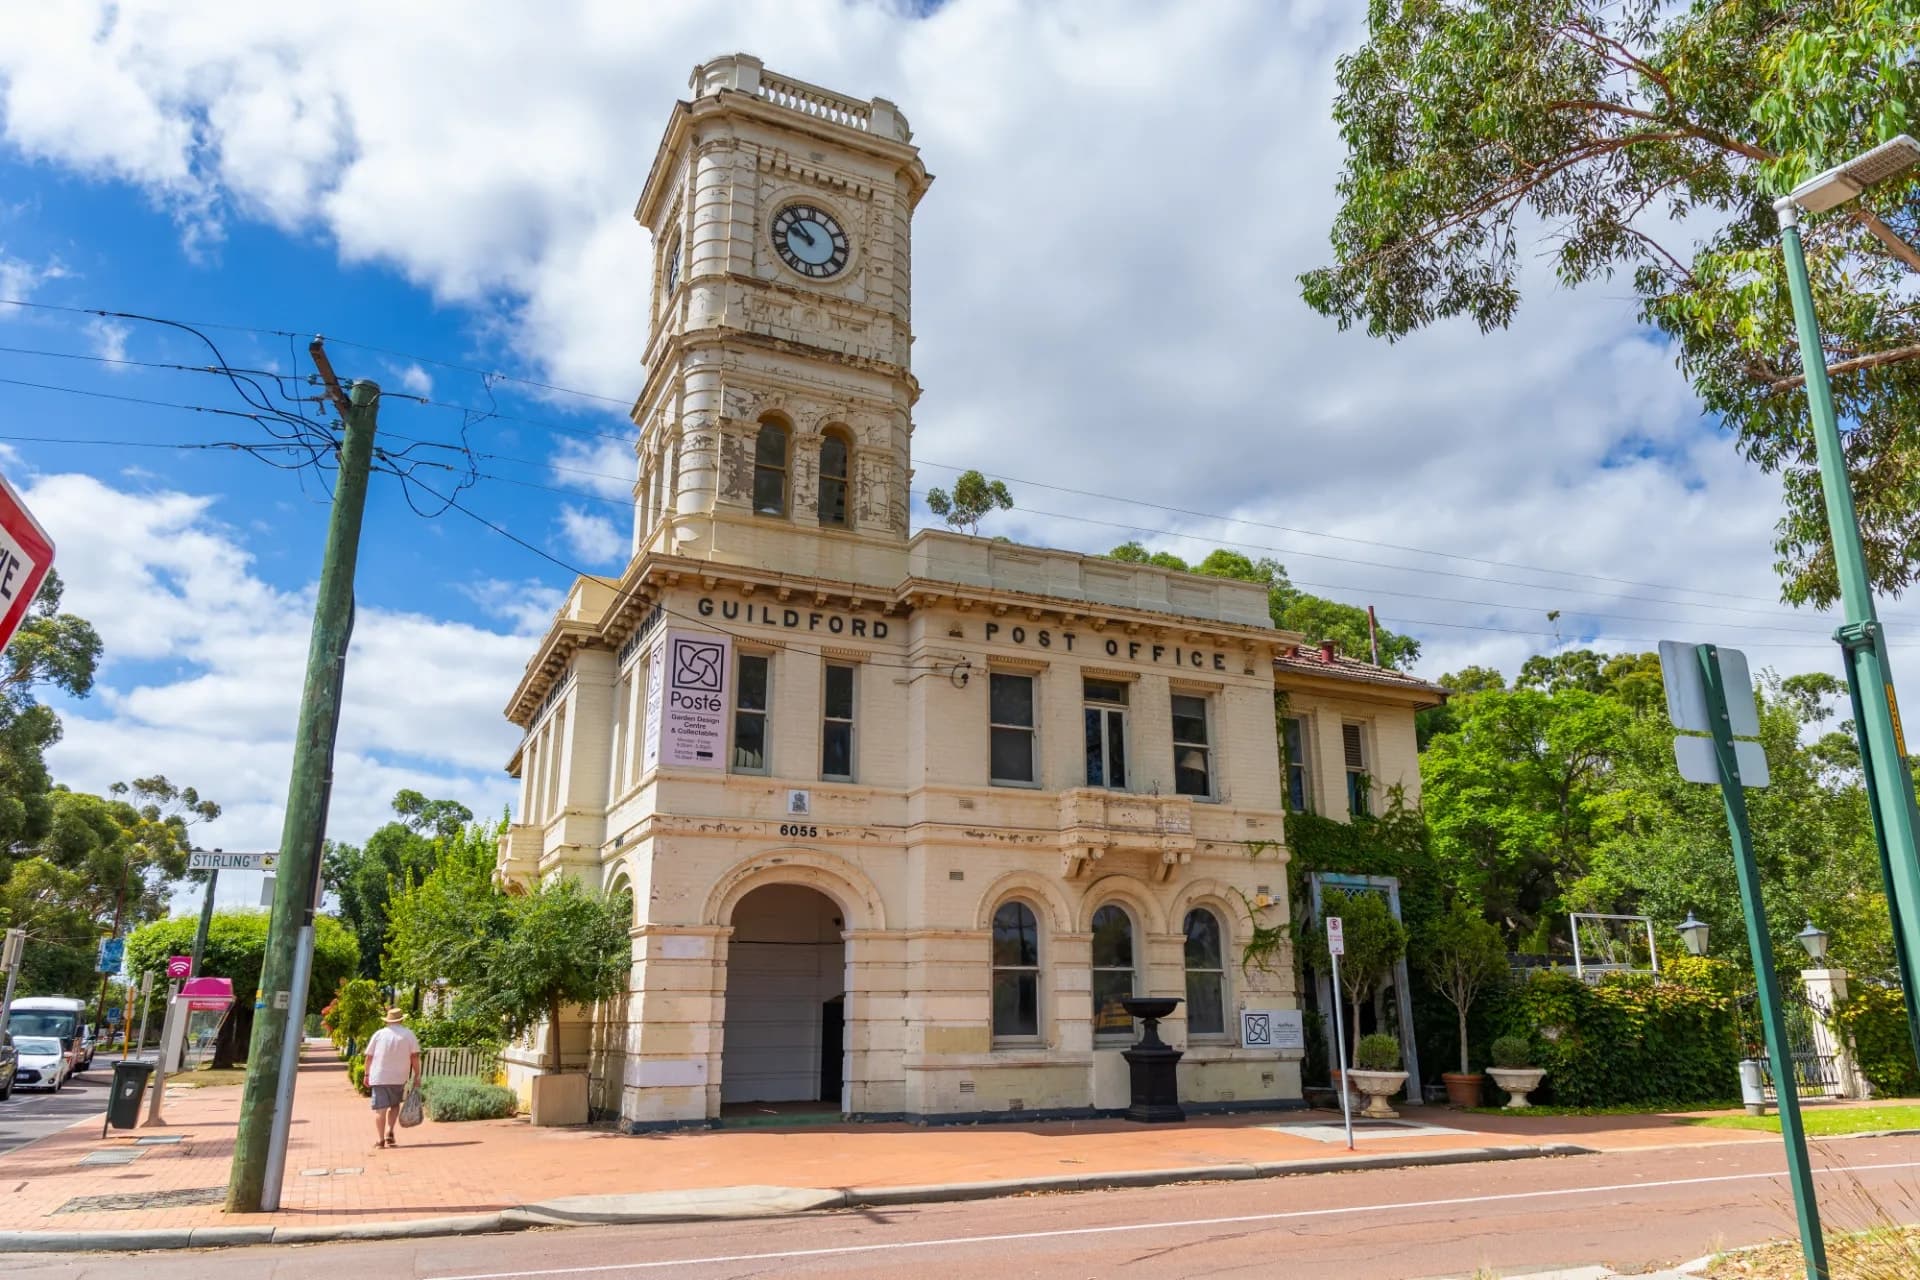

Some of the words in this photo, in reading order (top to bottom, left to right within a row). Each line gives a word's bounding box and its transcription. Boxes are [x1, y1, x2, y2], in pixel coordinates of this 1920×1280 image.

[698, 596, 889, 639] GUILDFORD
[985, 621, 1076, 651] POST
[1105, 639, 1227, 671] OFFICE
[670, 691, 722, 712] Posté
[671, 713, 696, 722] Garden
[696, 715, 720, 724] Design
[677, 728, 719, 736] Collectables
[780, 824, 818, 838] 6055
[192, 854, 250, 868] STIRLING
